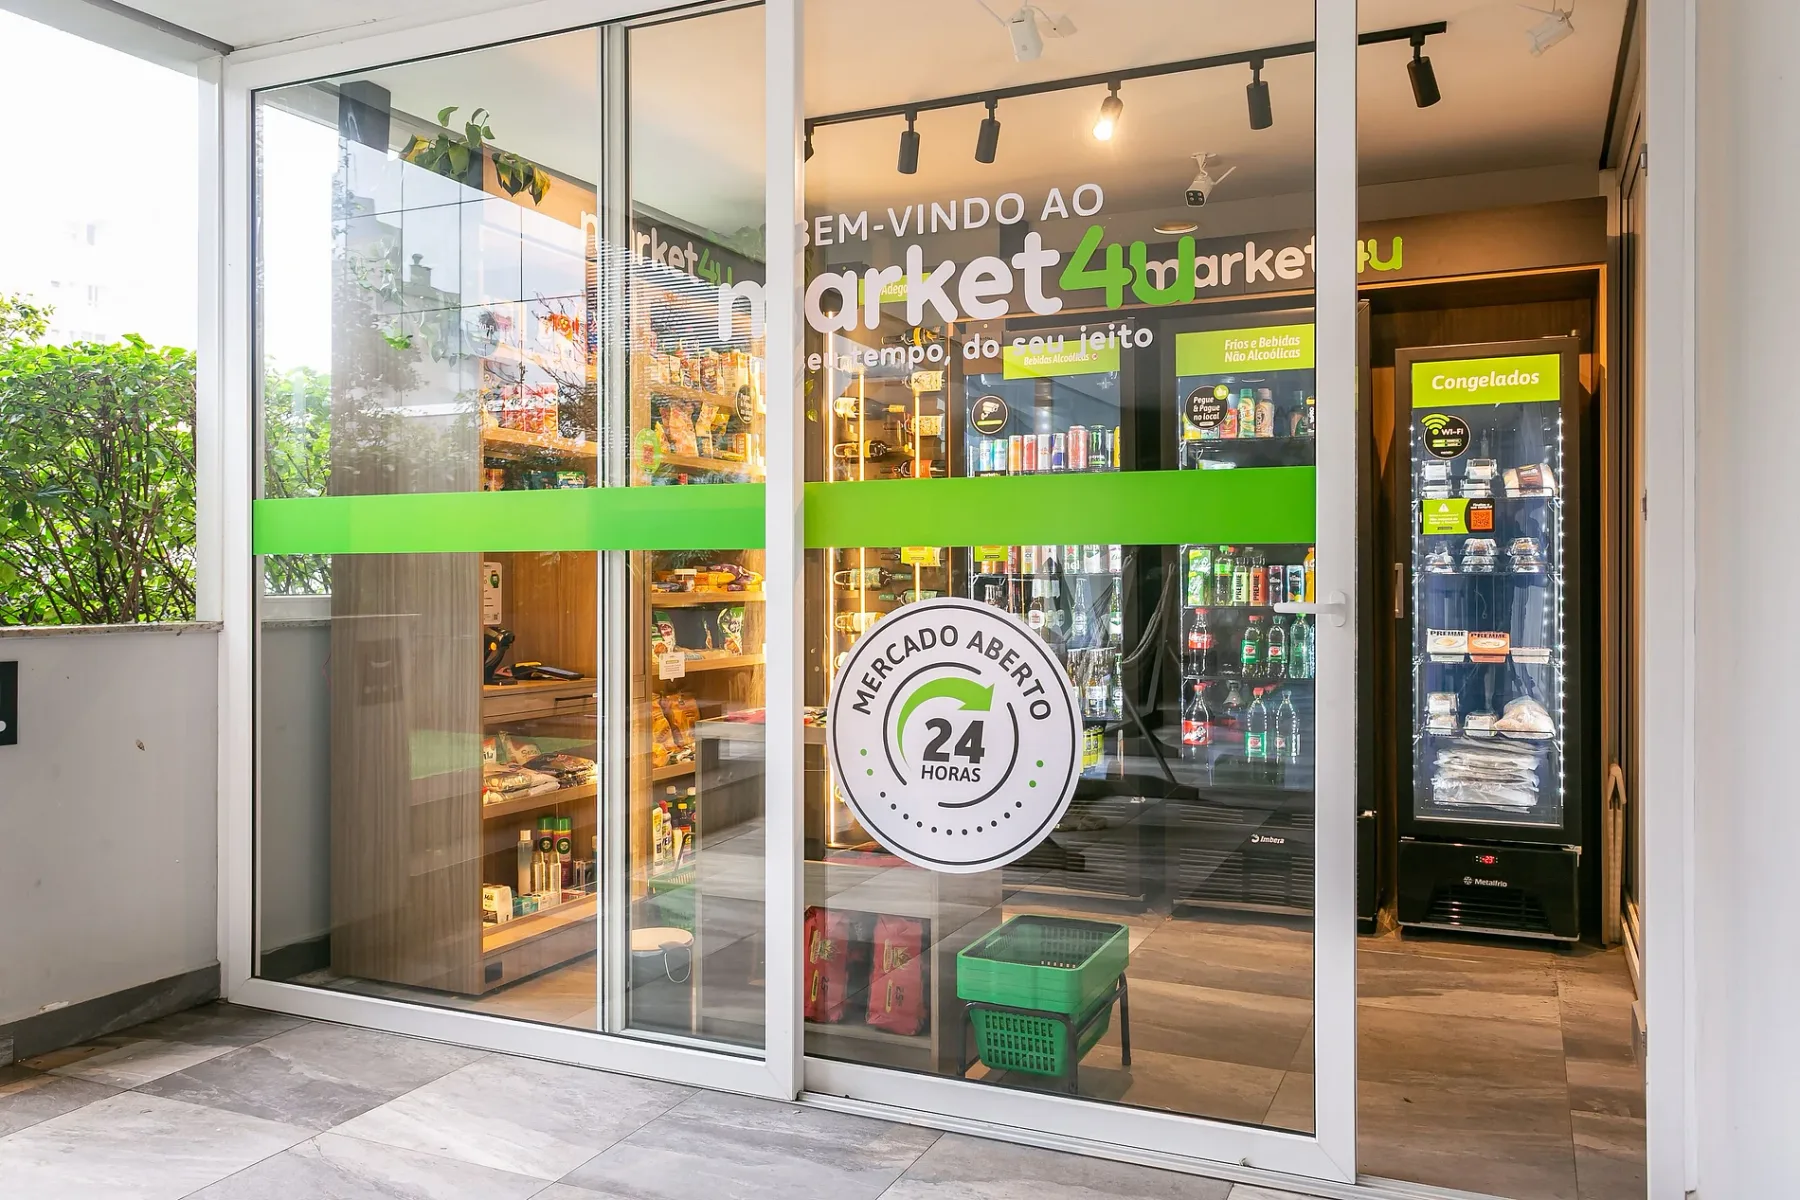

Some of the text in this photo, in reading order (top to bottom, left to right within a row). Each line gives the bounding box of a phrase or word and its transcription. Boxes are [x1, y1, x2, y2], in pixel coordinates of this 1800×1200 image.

[1040, 183, 1104, 221] AO
[852, 344, 951, 369] tempo,
[963, 333, 999, 360] do
[1012, 335, 1064, 356] seu
[1078, 324, 1154, 356] jeito
[1224, 334, 1300, 351] Frios e Bebidas
[1023, 354, 1052, 366] Bebidas
[1224, 348, 1301, 363] Não Alcoólicas
[1431, 369, 1540, 392] Congelados
[1193, 396, 1215, 405] Pegue
[1199, 404, 1220, 413] Pague
[1203, 412, 1220, 420] local
[852, 625, 1052, 721] MERCADO ABERTO
[923, 717, 986, 764] 24
[921, 764, 981, 783] HORAS
[1260, 835, 1285, 844] Imbera
[1474, 878, 1508, 888] Metalfrio
